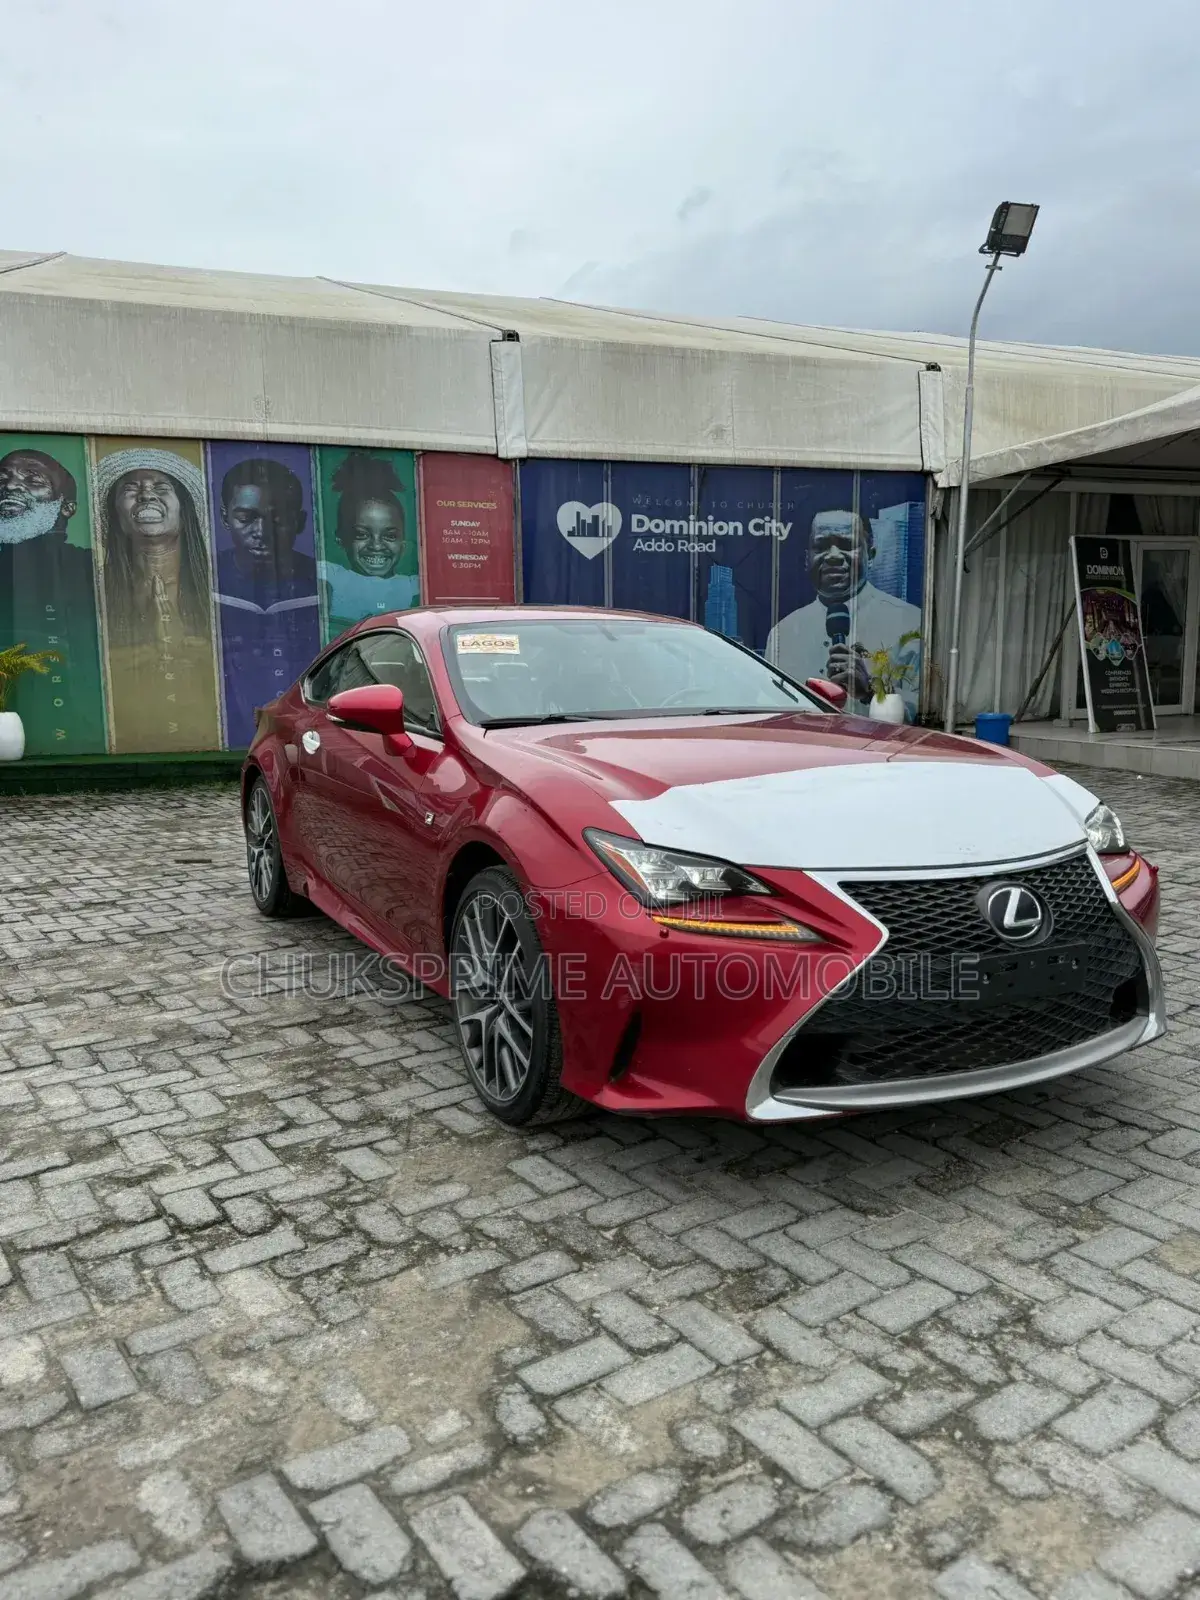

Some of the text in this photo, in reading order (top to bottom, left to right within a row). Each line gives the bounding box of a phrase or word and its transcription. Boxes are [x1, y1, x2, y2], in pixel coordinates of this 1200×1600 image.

[436, 499, 497, 510] OUR SERVICES
[632, 496, 700, 508] WELCOM
[711, 501, 728, 509] TO
[450, 520, 481, 528] SUNDAY
[631, 514, 793, 541] Dominion City
[633, 538, 716, 553] Addo Road
[461, 640, 516, 648] LAGOS
[45, 604, 67, 741] WORSHIP
